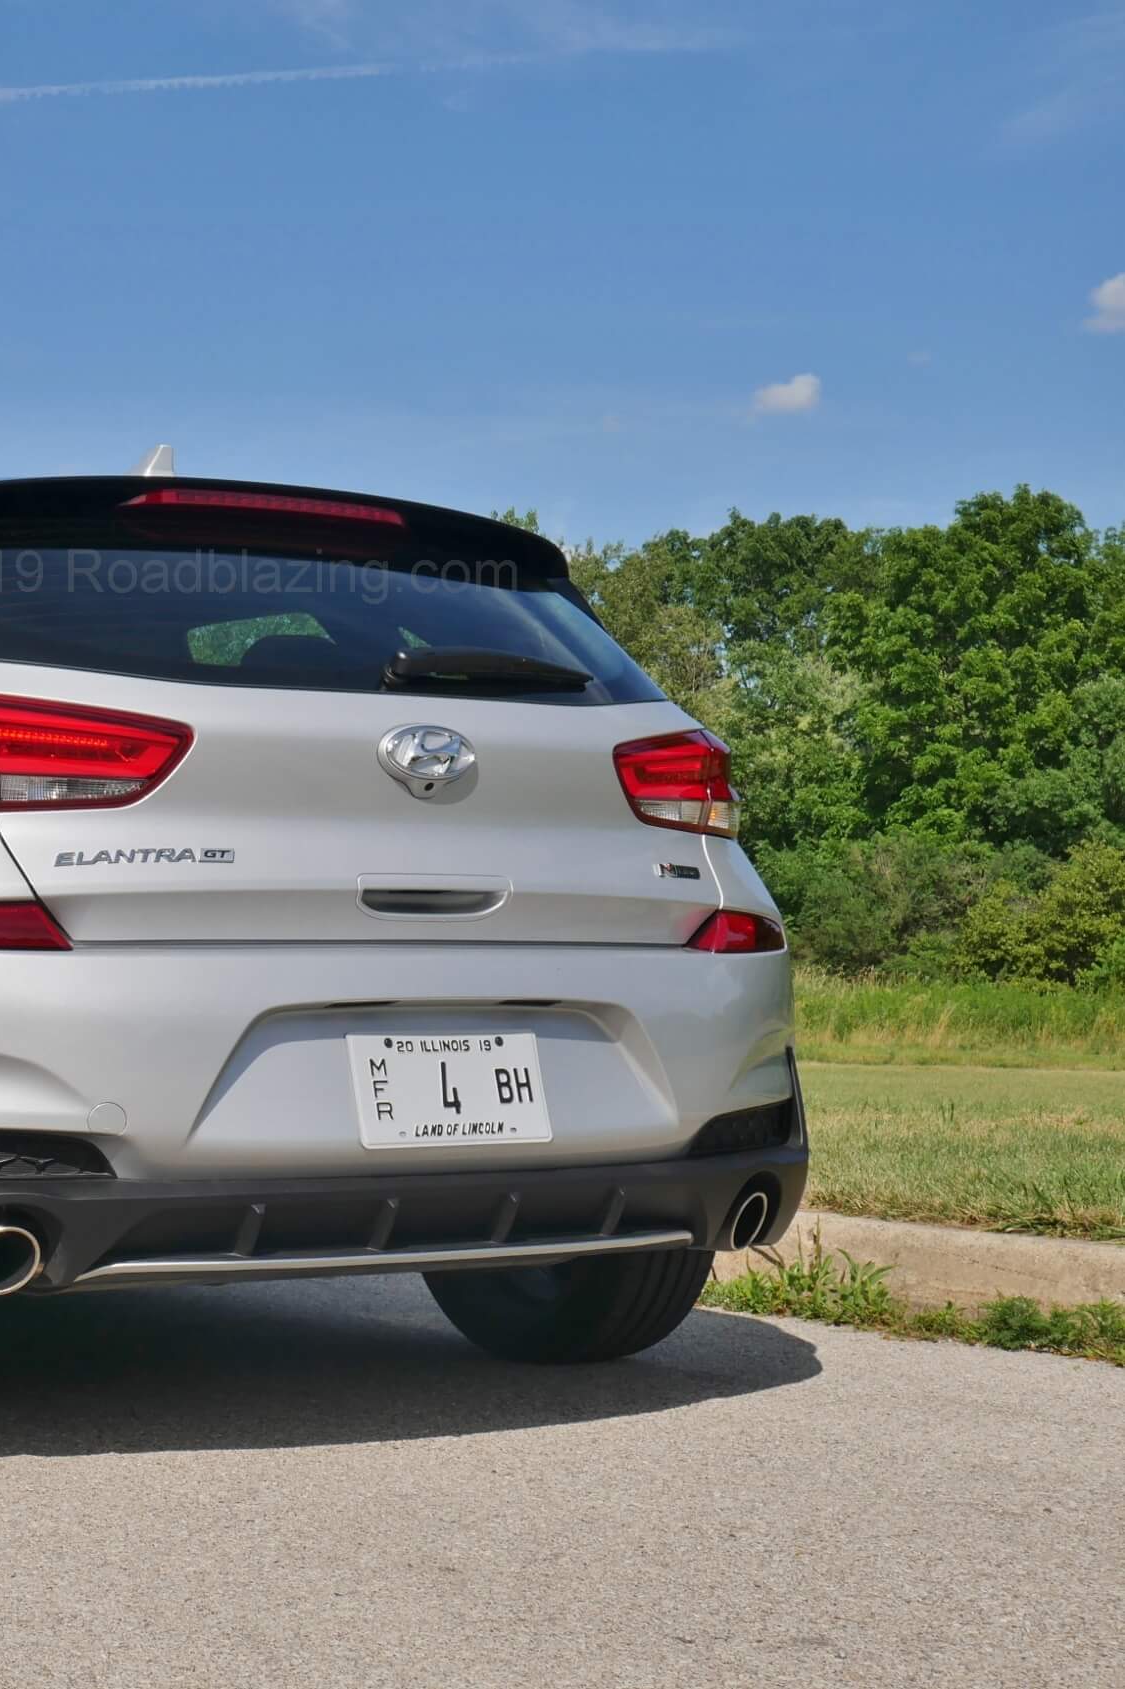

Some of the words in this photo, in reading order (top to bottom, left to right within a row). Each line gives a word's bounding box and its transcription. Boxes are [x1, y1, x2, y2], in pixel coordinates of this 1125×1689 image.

[54, 848, 197, 867] ELANTRA
[396, 1041, 413, 1052] 20
[420, 1040, 470, 1052] ILLINOIS
[479, 1040, 492, 1051] 19
[440, 1061, 461, 1114] 4
[495, 1067, 534, 1104] BH
[415, 1124, 443, 1137] LAND
[446, 1123, 459, 1136] OF
[462, 1122, 504, 1135] LINCOLN
